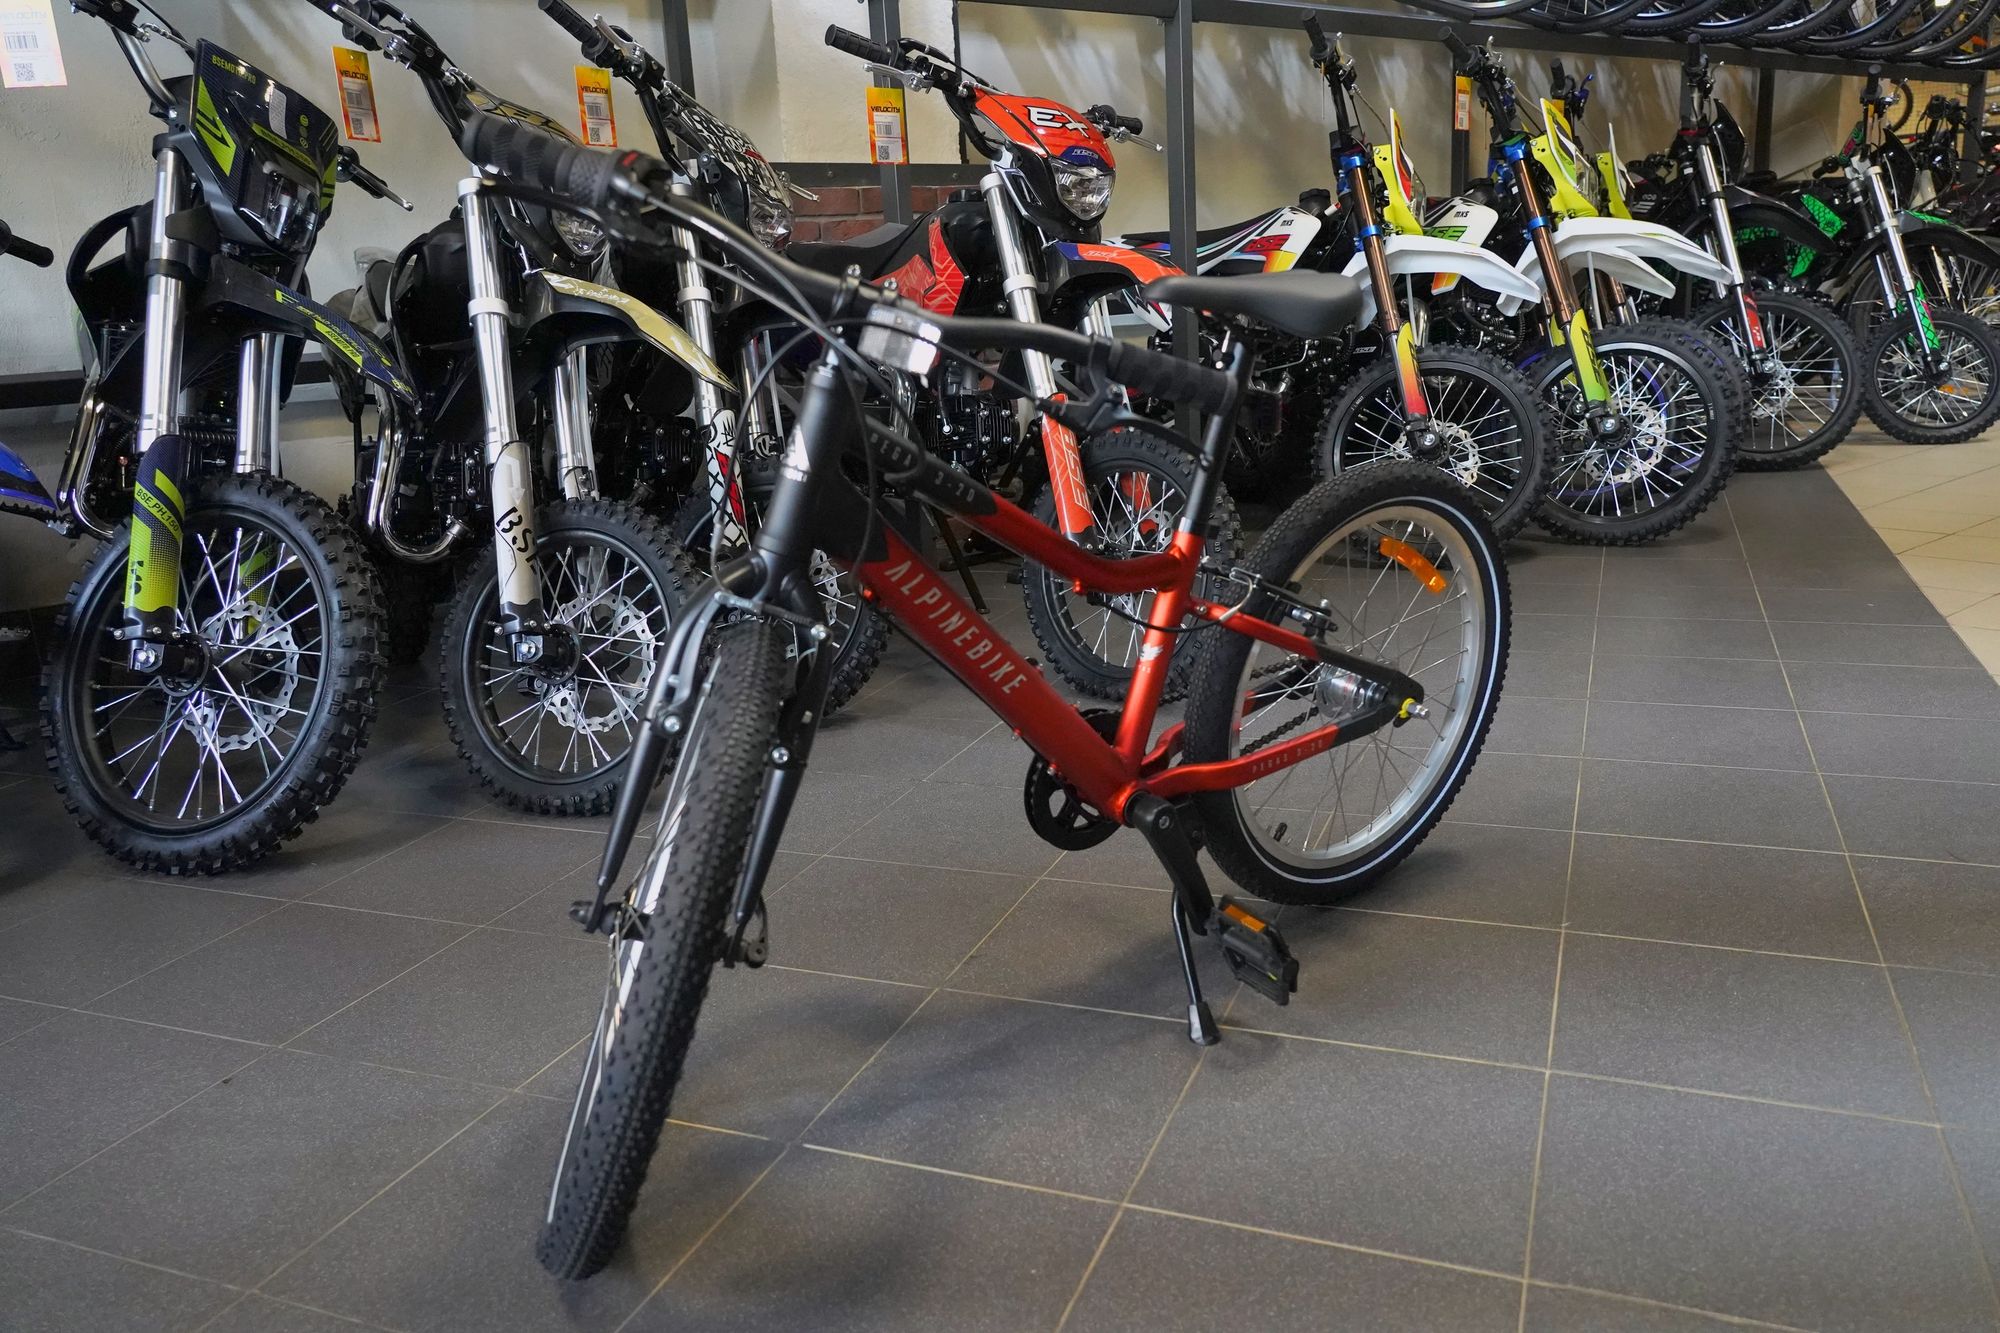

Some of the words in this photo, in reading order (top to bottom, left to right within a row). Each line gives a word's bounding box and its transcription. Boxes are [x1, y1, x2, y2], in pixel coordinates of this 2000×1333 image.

[340, 69, 368, 80] VELOCITY
[581, 86, 608, 94] VELOCITY
[871, 105, 900, 113] VELOCITY
[1023, 104, 1091, 139] EX
[884, 560, 1027, 694] ALPINEBIKE
